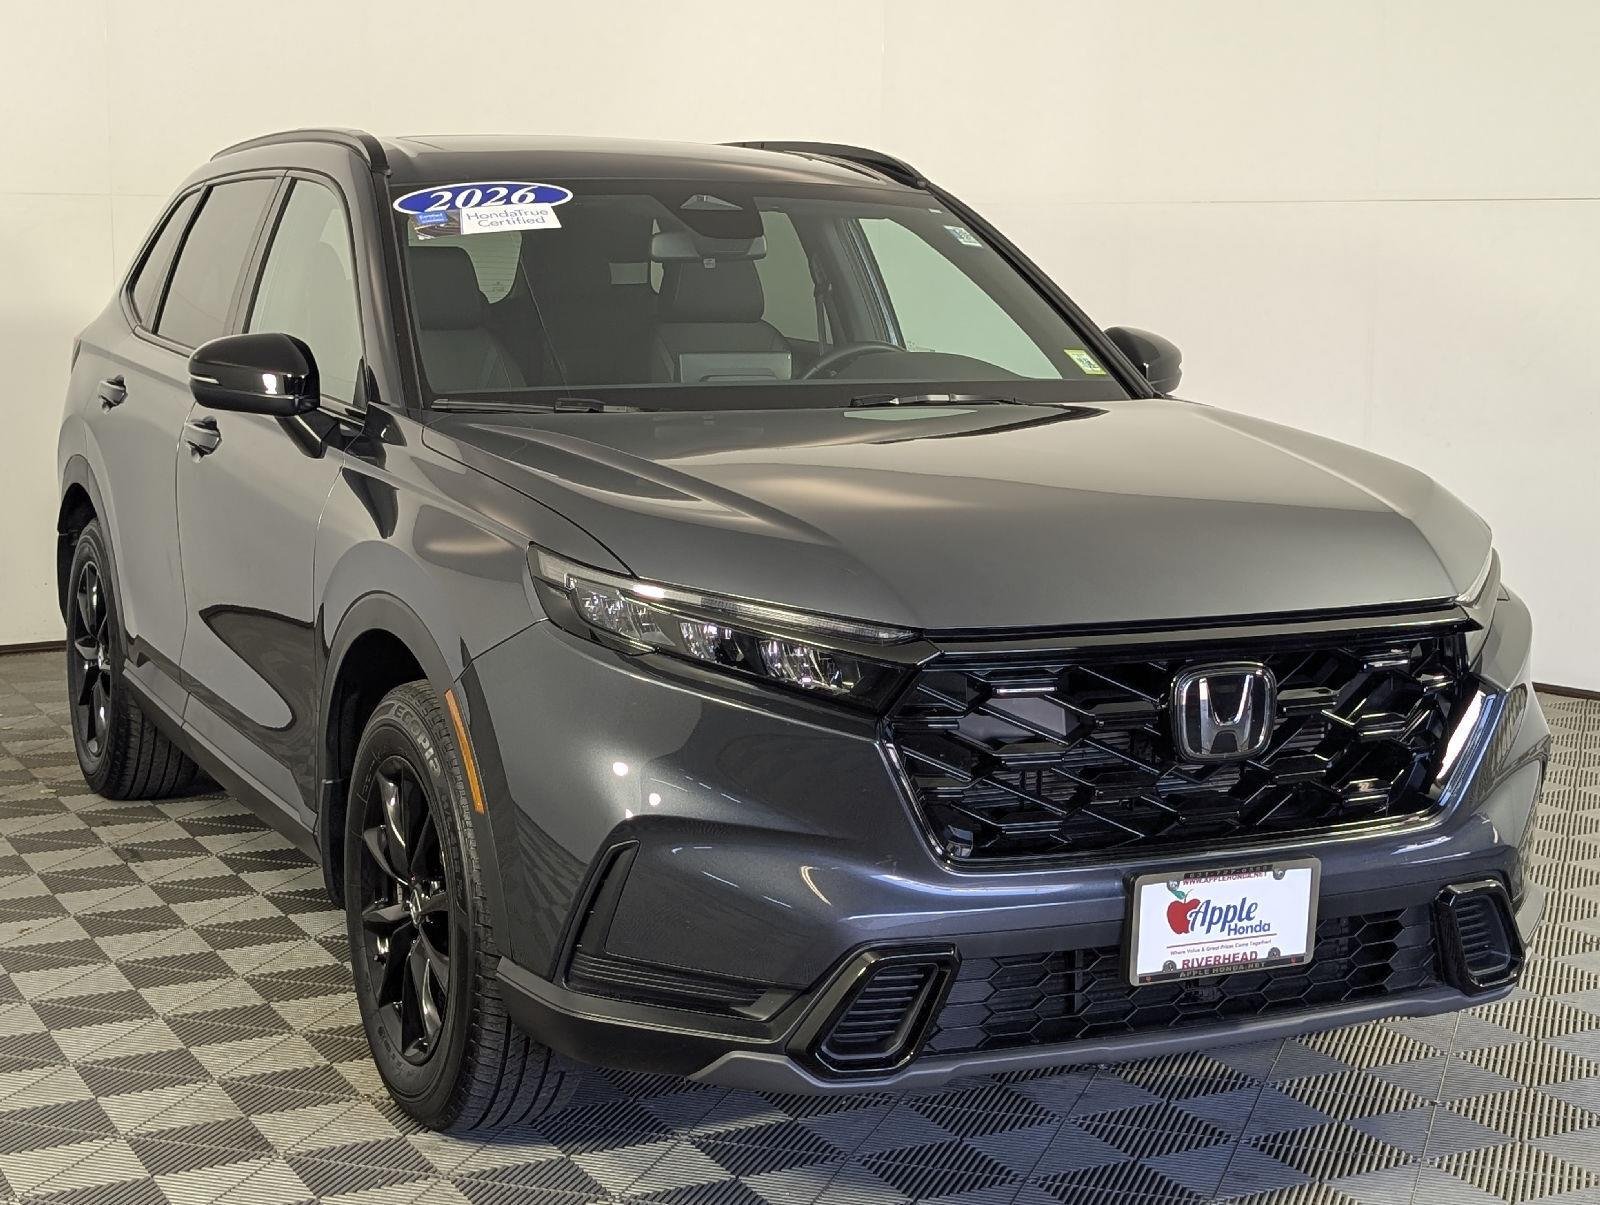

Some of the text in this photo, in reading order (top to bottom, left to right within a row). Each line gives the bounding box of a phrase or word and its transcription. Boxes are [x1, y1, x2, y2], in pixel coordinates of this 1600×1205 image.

[424, 185, 539, 212] 2026
[466, 209, 549, 221] HondaTrue
[477, 216, 546, 228] Certified
[1188, 897, 1258, 934] Apple
[1227, 920, 1271, 936] Honda
[1181, 950, 1258, 970] RIVERHEAD
[1179, 969, 1210, 978] APPLE
